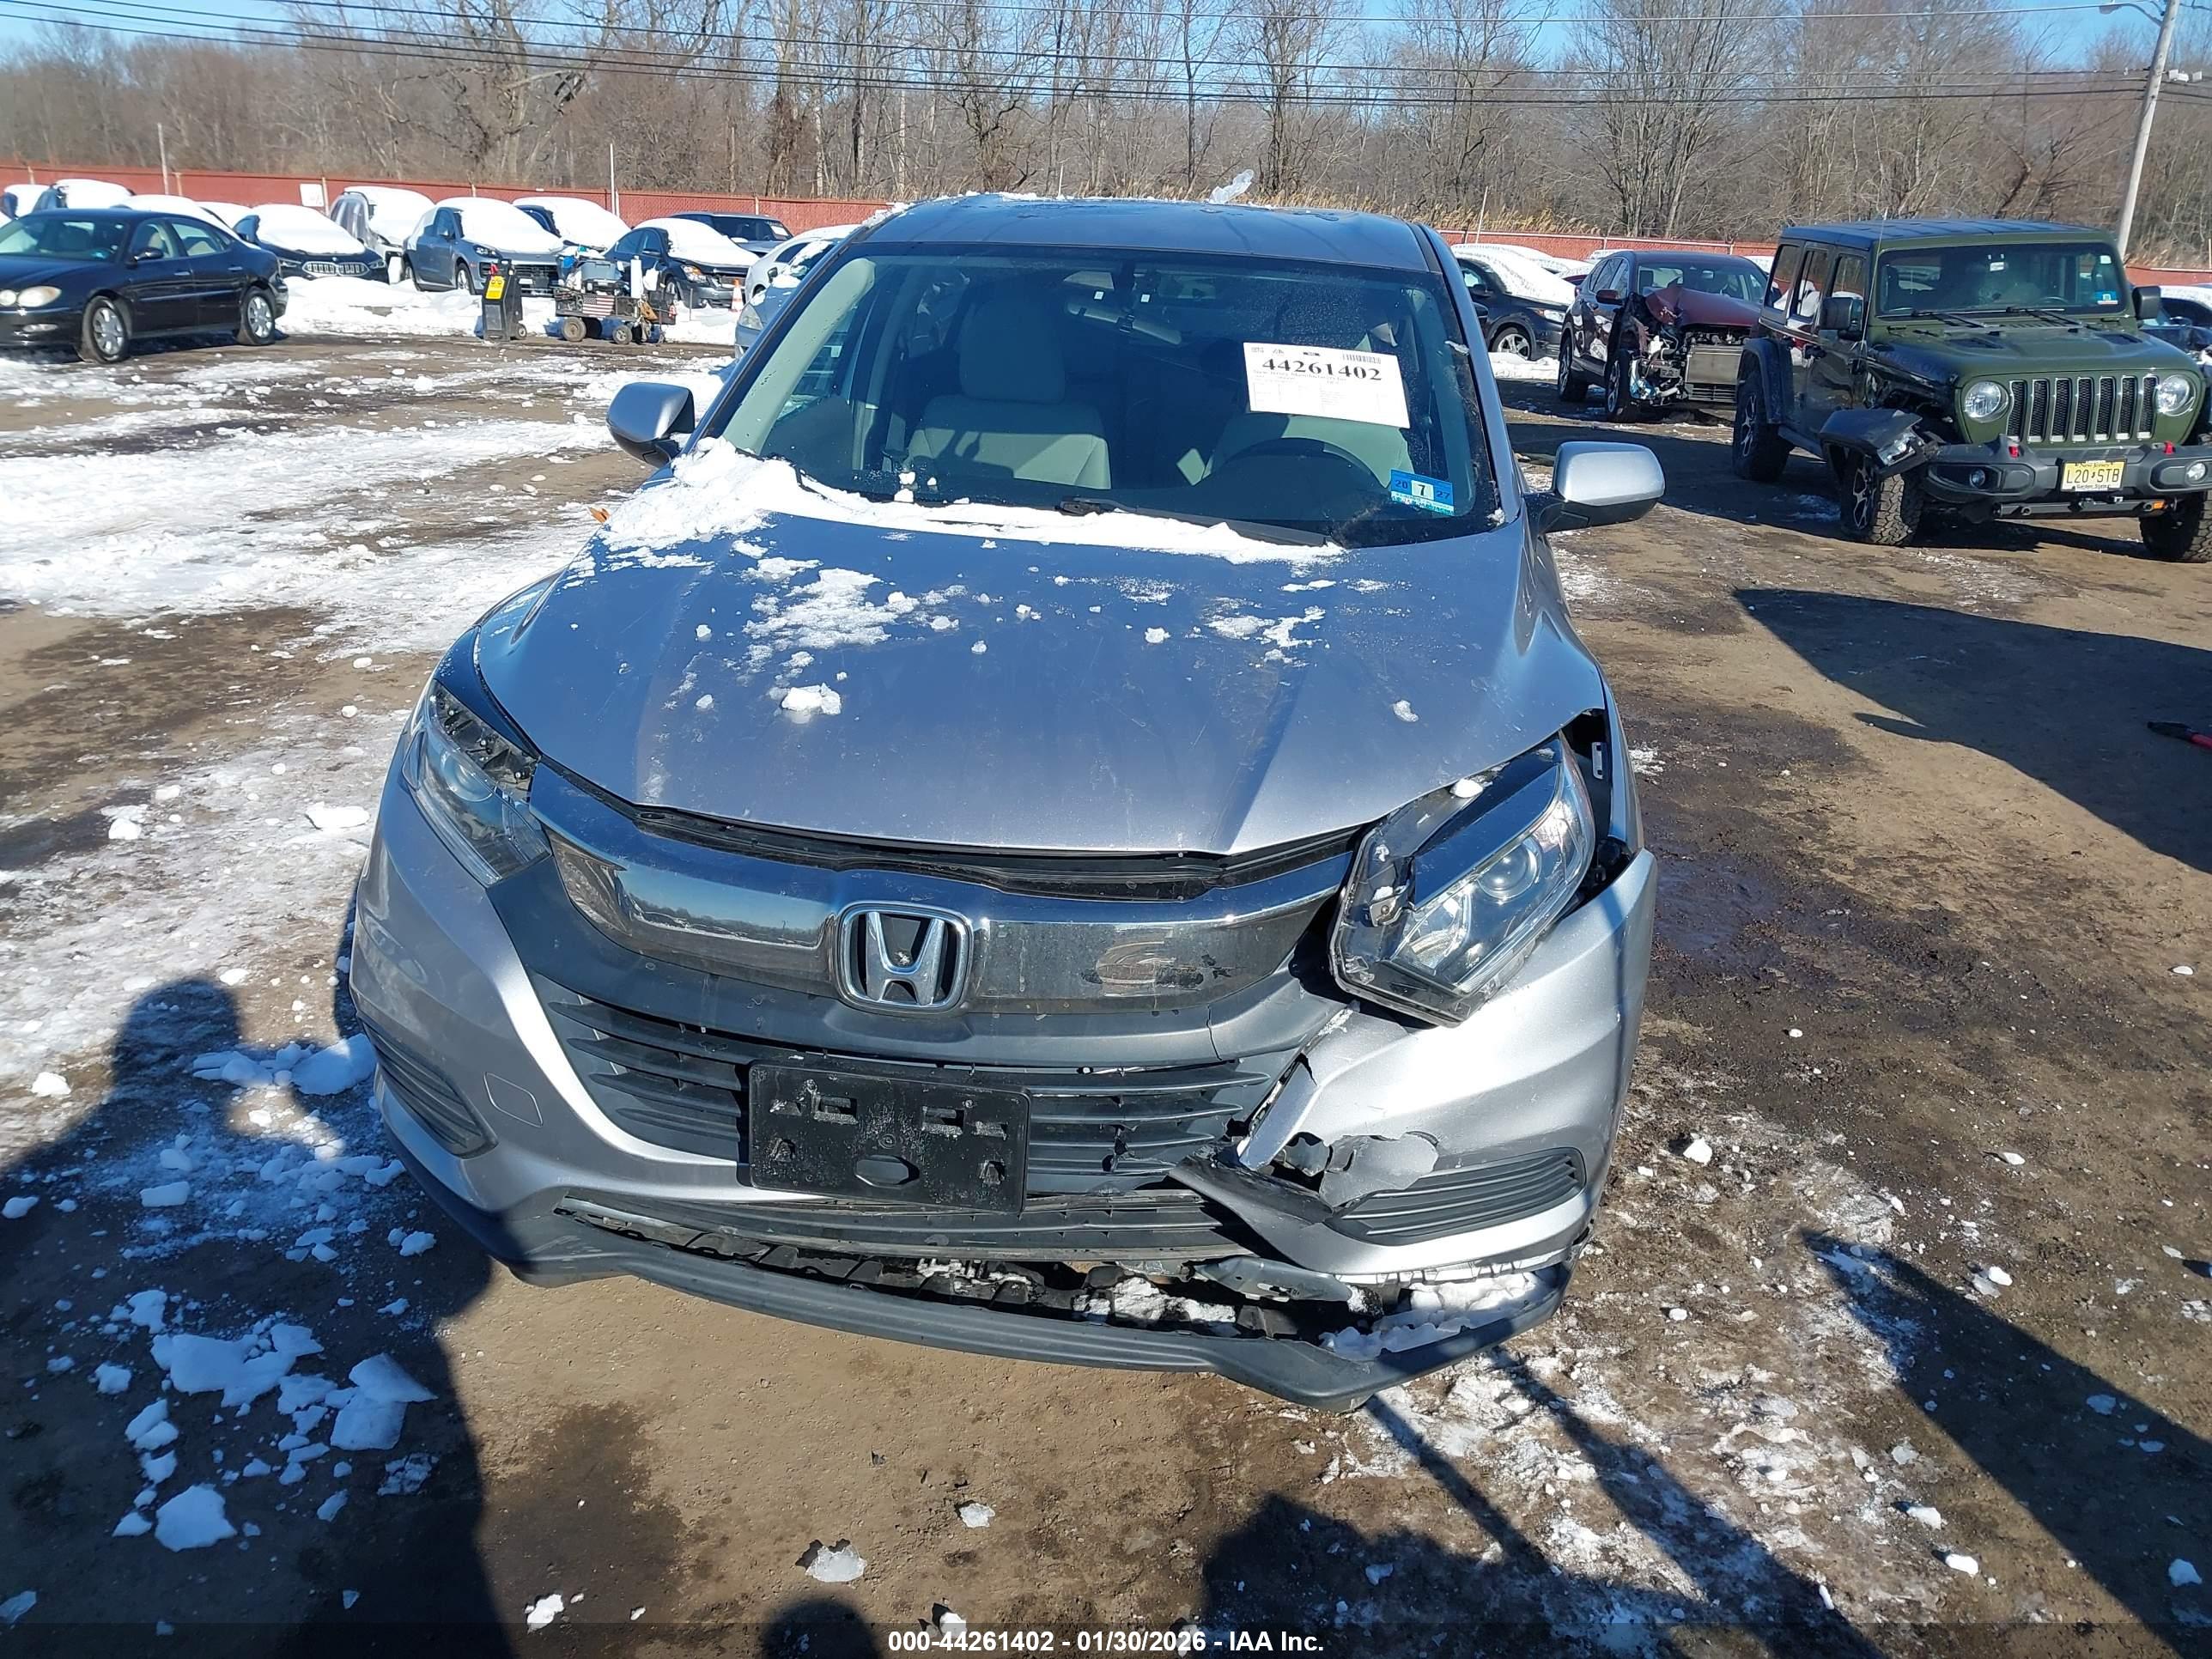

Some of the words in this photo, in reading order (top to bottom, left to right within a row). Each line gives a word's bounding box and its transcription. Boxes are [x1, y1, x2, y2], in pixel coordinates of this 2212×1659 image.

[1261, 358, 1382, 380] 44261402
[1395, 479, 1408, 489] 20
[1418, 484, 1425, 496] 7
[1437, 490, 1450, 500] 27
